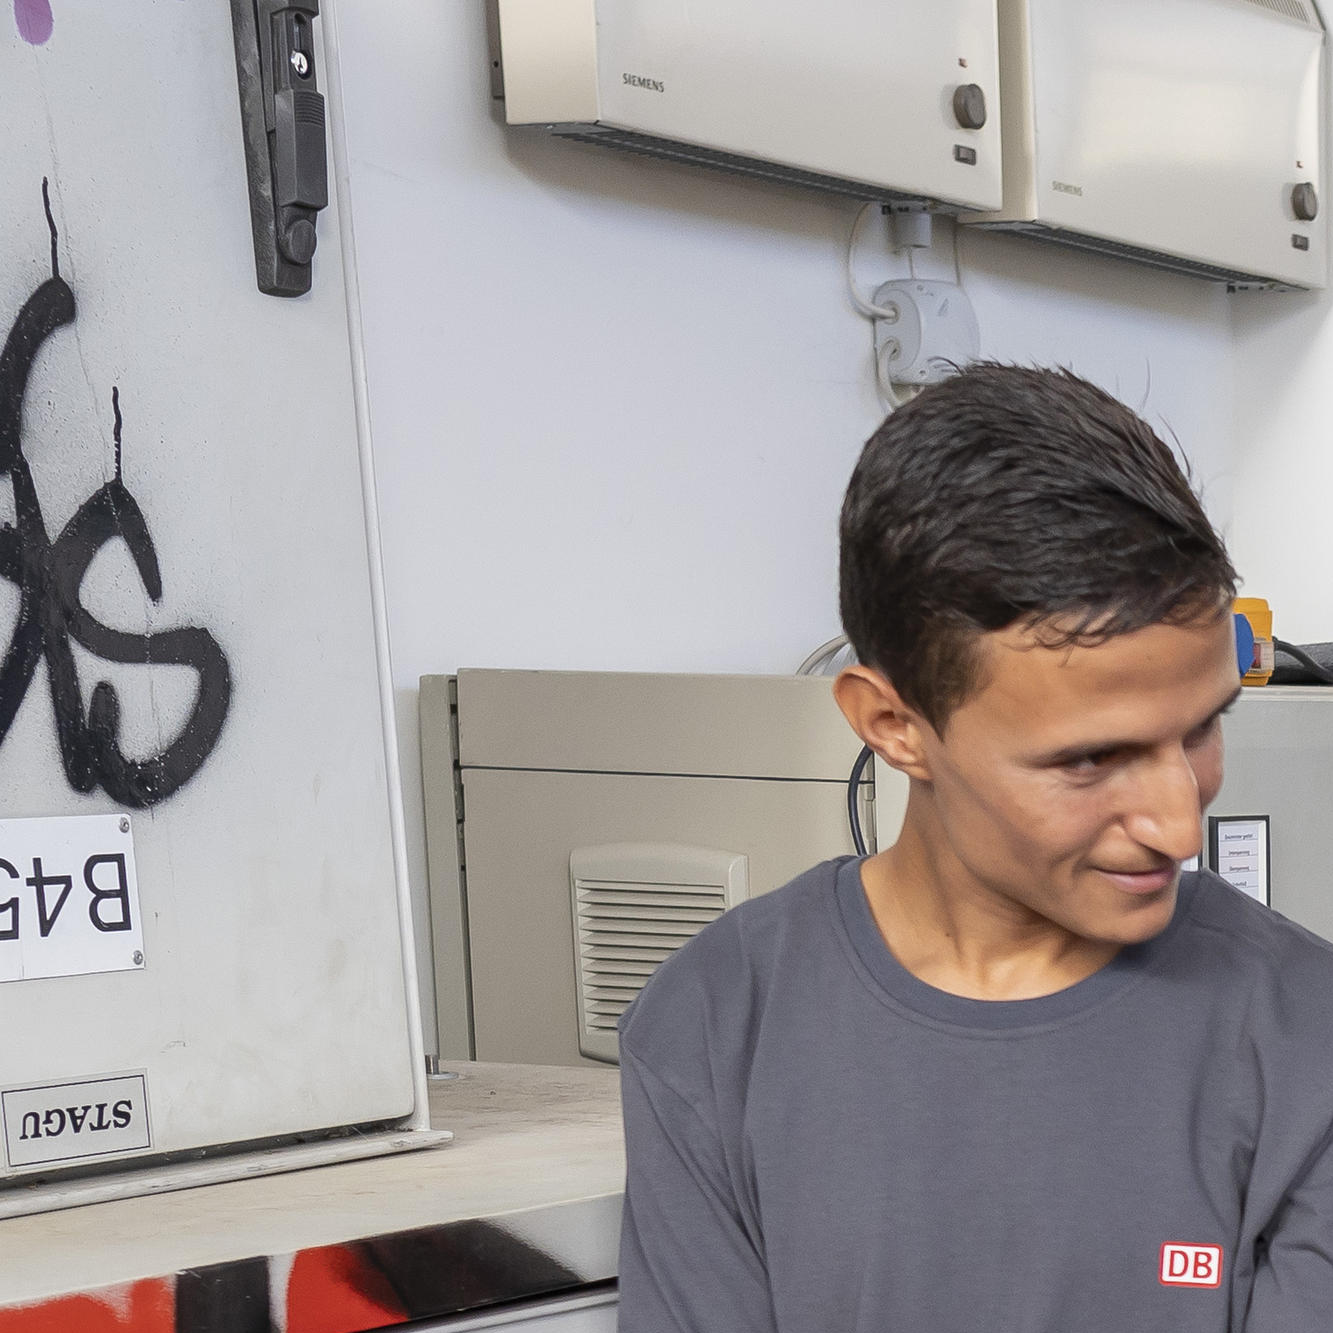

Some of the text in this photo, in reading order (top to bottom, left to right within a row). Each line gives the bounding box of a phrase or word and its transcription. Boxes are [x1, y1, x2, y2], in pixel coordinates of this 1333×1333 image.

[622, 72, 665, 93] SIEMENS
[19, 1099, 133, 1141] STAGU
[1169, 1249, 1213, 1279] DB
